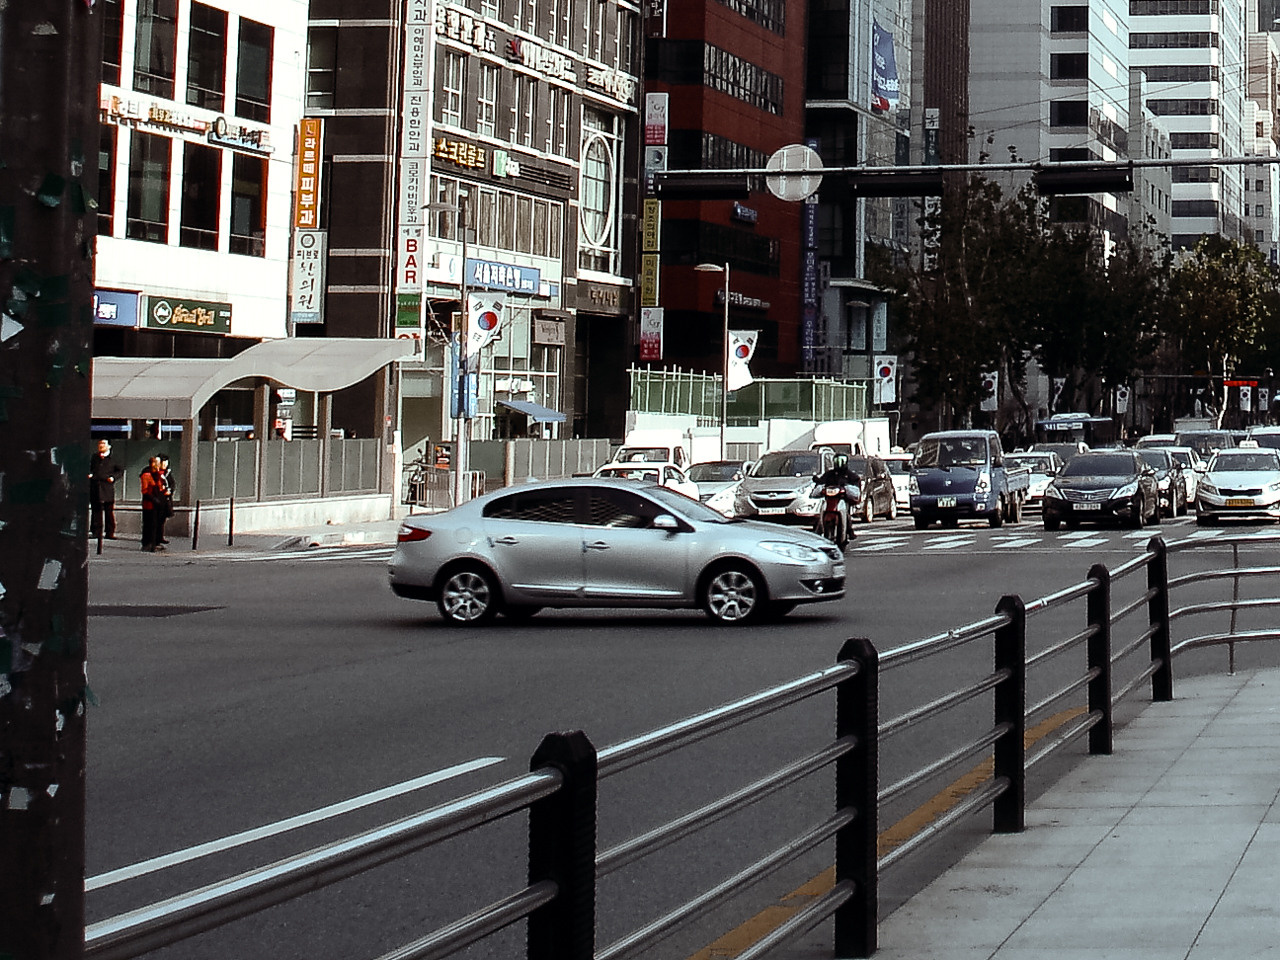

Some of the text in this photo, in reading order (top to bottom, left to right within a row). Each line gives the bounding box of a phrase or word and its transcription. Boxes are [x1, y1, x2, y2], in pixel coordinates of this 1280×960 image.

[435, 137, 486, 169] 스크린골프
[404, 238, 418, 284] BAR
[473, 262, 522, 290] 서울저축은행
